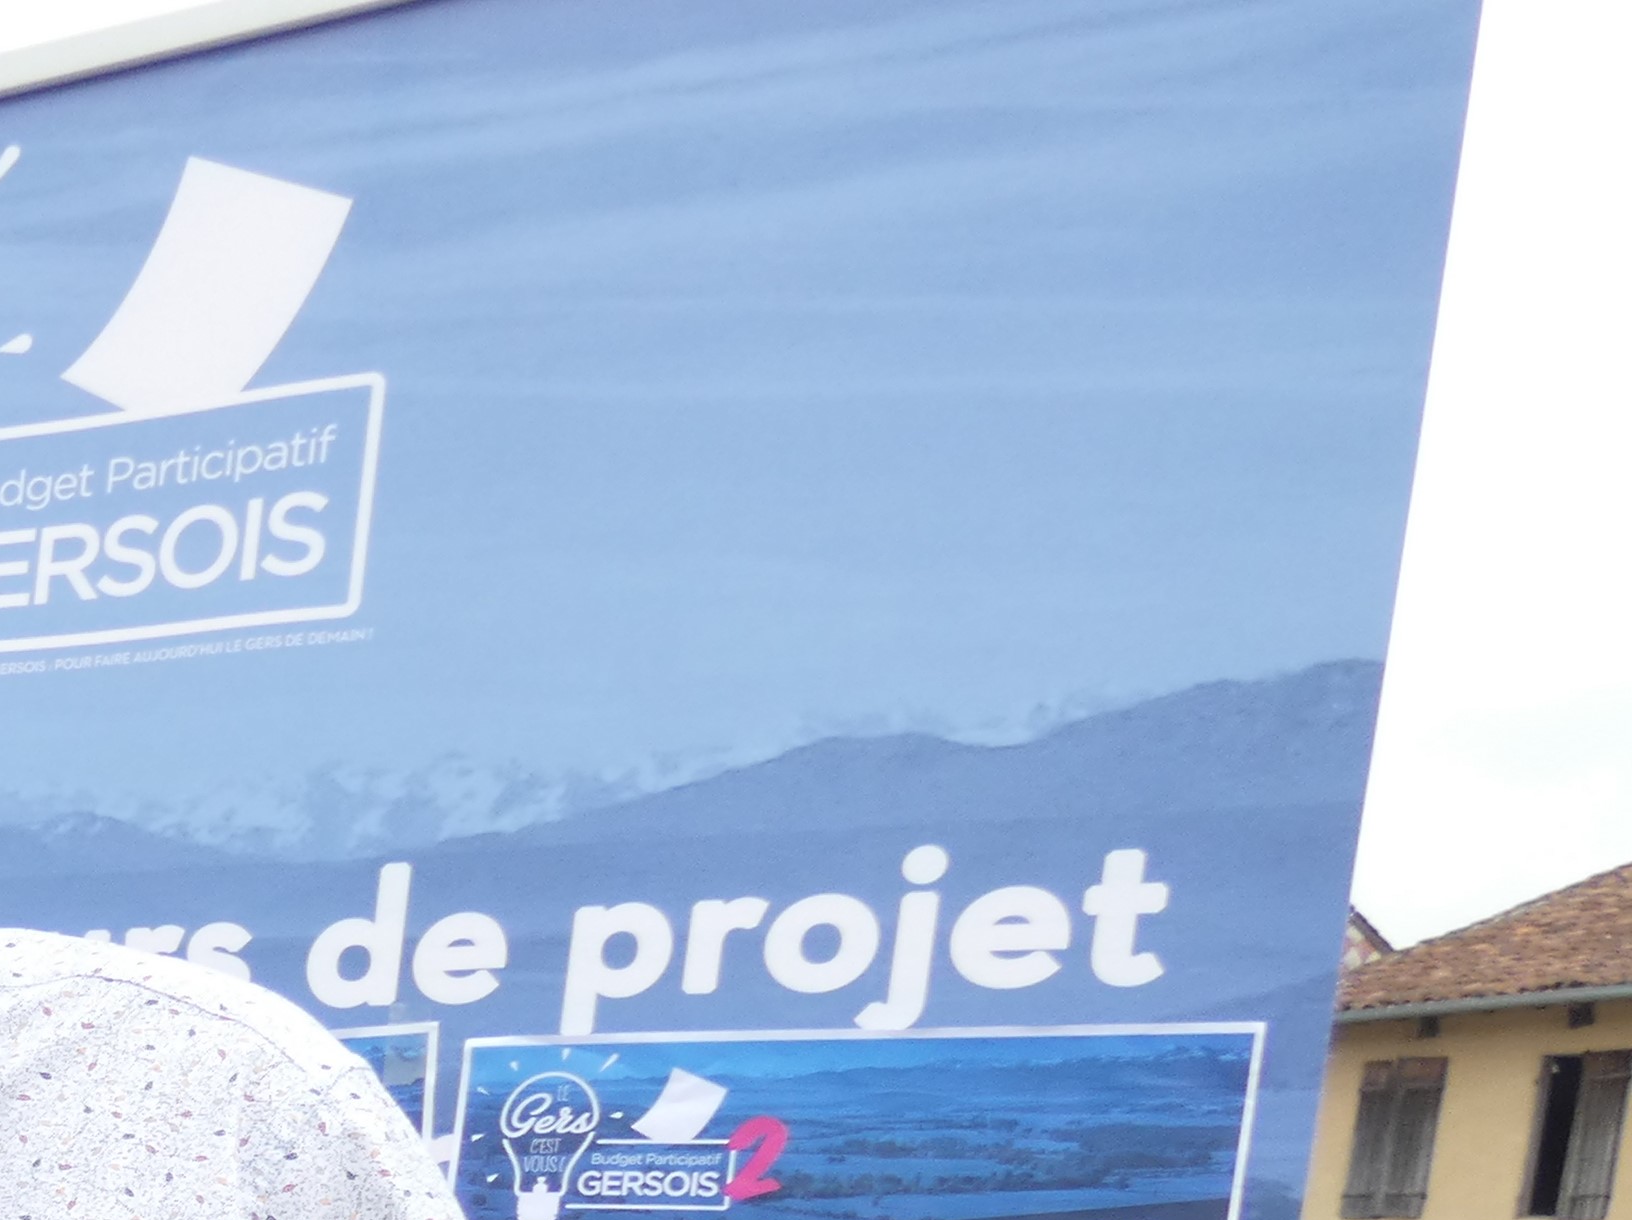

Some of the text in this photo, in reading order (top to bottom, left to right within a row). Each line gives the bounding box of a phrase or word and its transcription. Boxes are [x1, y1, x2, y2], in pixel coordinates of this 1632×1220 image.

[105, 422, 339, 494] Participatif
[55, 655, 93, 671] POUR
[95, 652, 131, 667] FAIRE
[133, 641, 223, 663] AUJOURD'HUI
[225, 639, 242, 653] LE
[245, 635, 283, 651] GERS
[285, 633, 304, 647] DE
[306, 846, 1169, 1034] de projet
[557, 1084, 570, 1102] LE
[509, 1092, 595, 1139] Gers
[590, 1152, 722, 1169] Budget Participatif
[726, 1116, 787, 1201] 2
[577, 1171, 720, 1198] GERSOIS
